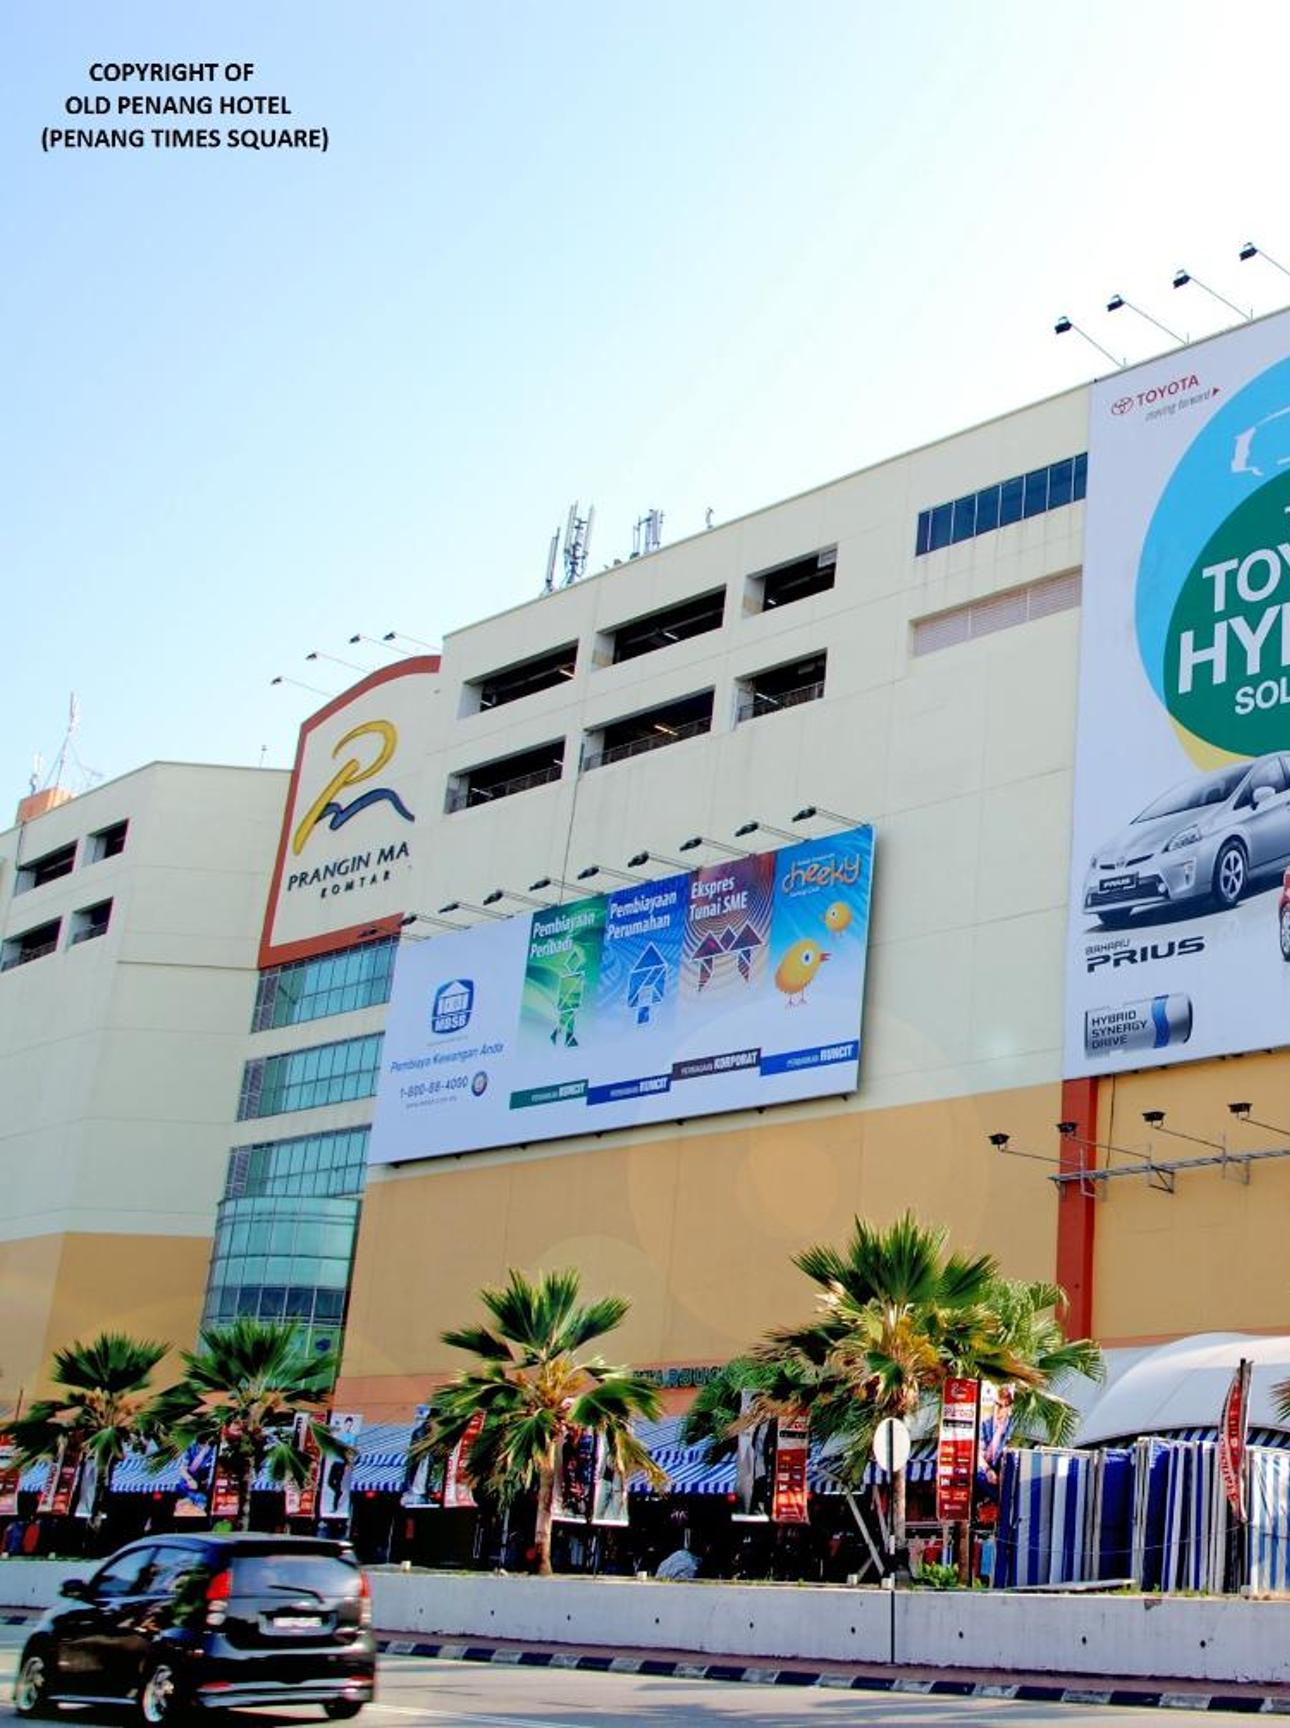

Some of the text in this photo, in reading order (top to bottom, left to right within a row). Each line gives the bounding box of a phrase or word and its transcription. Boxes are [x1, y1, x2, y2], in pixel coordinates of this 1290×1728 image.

[1136, 373, 1200, 407] TOYOTA
[286, 852, 371, 892] PRANGIN
[320, 869, 392, 899] KOMTAR
[781, 852, 862, 894] cheeky
[691, 876, 736, 901] Ekspres
[609, 890, 678, 919] Pembiayaan
[689, 891, 748, 921] Tunai SME
[532, 910, 596, 939] Pembiayaan
[607, 913, 671, 941] Perumahan
[1086, 935, 1206, 974] PRIUS
[434, 1014, 466, 1032] MBSB
[1091, 1010, 1137, 1027] HYBRID
[1091, 1020, 1148, 1039] SYNERGY
[1092, 1035, 1128, 1050] DRIVE
